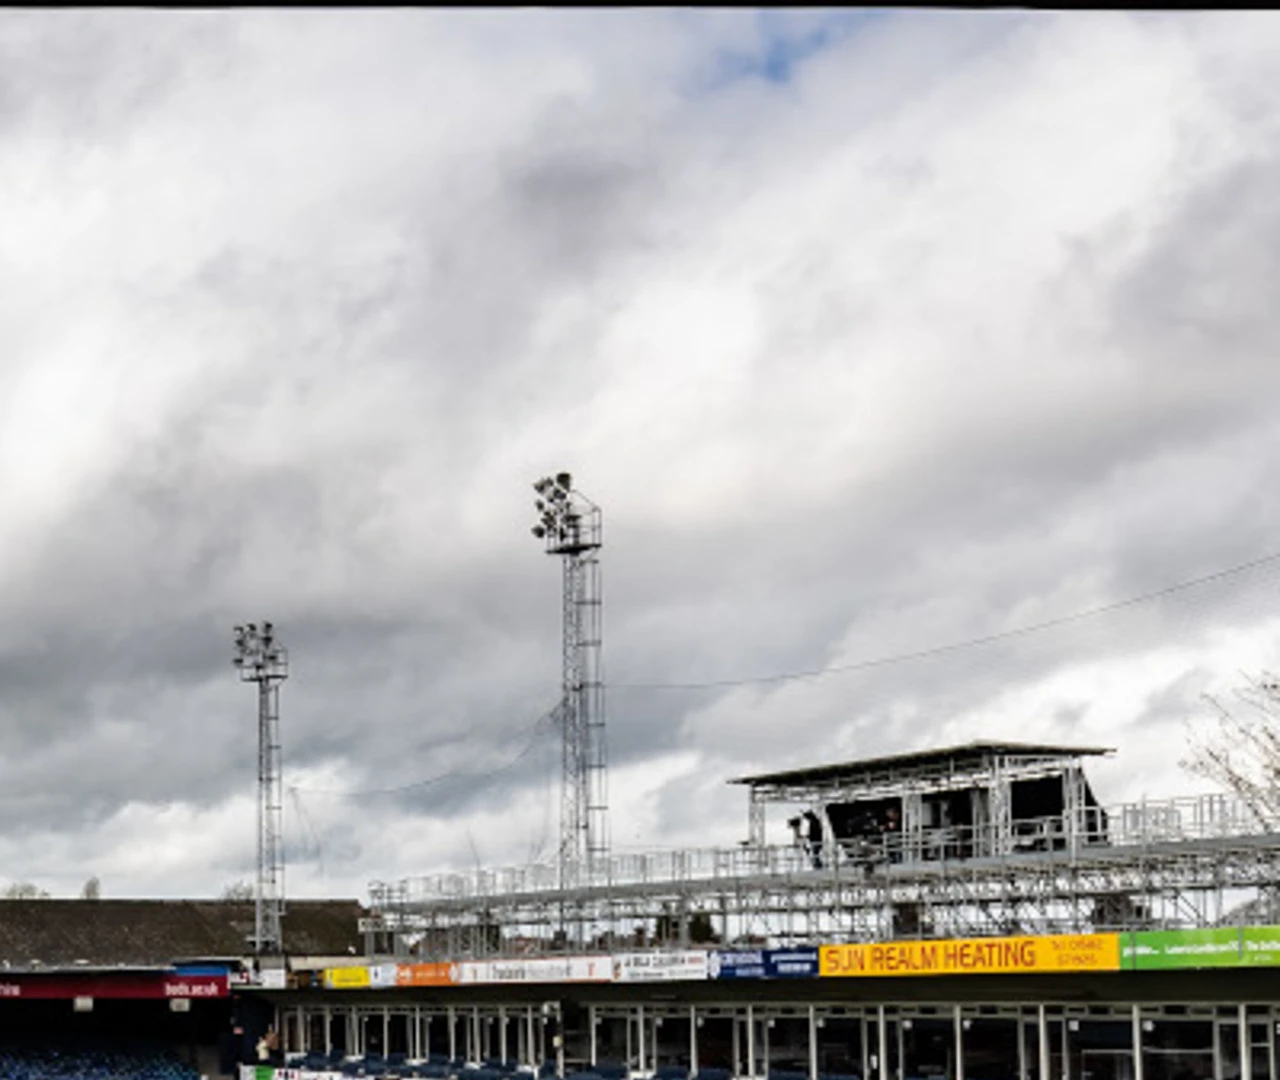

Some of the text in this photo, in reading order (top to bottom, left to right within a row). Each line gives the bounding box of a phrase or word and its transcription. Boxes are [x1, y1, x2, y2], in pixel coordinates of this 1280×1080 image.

[825, 951, 864, 971] SUN
[871, 946, 937, 971] REALM
[944, 941, 1036, 969] HEATING
